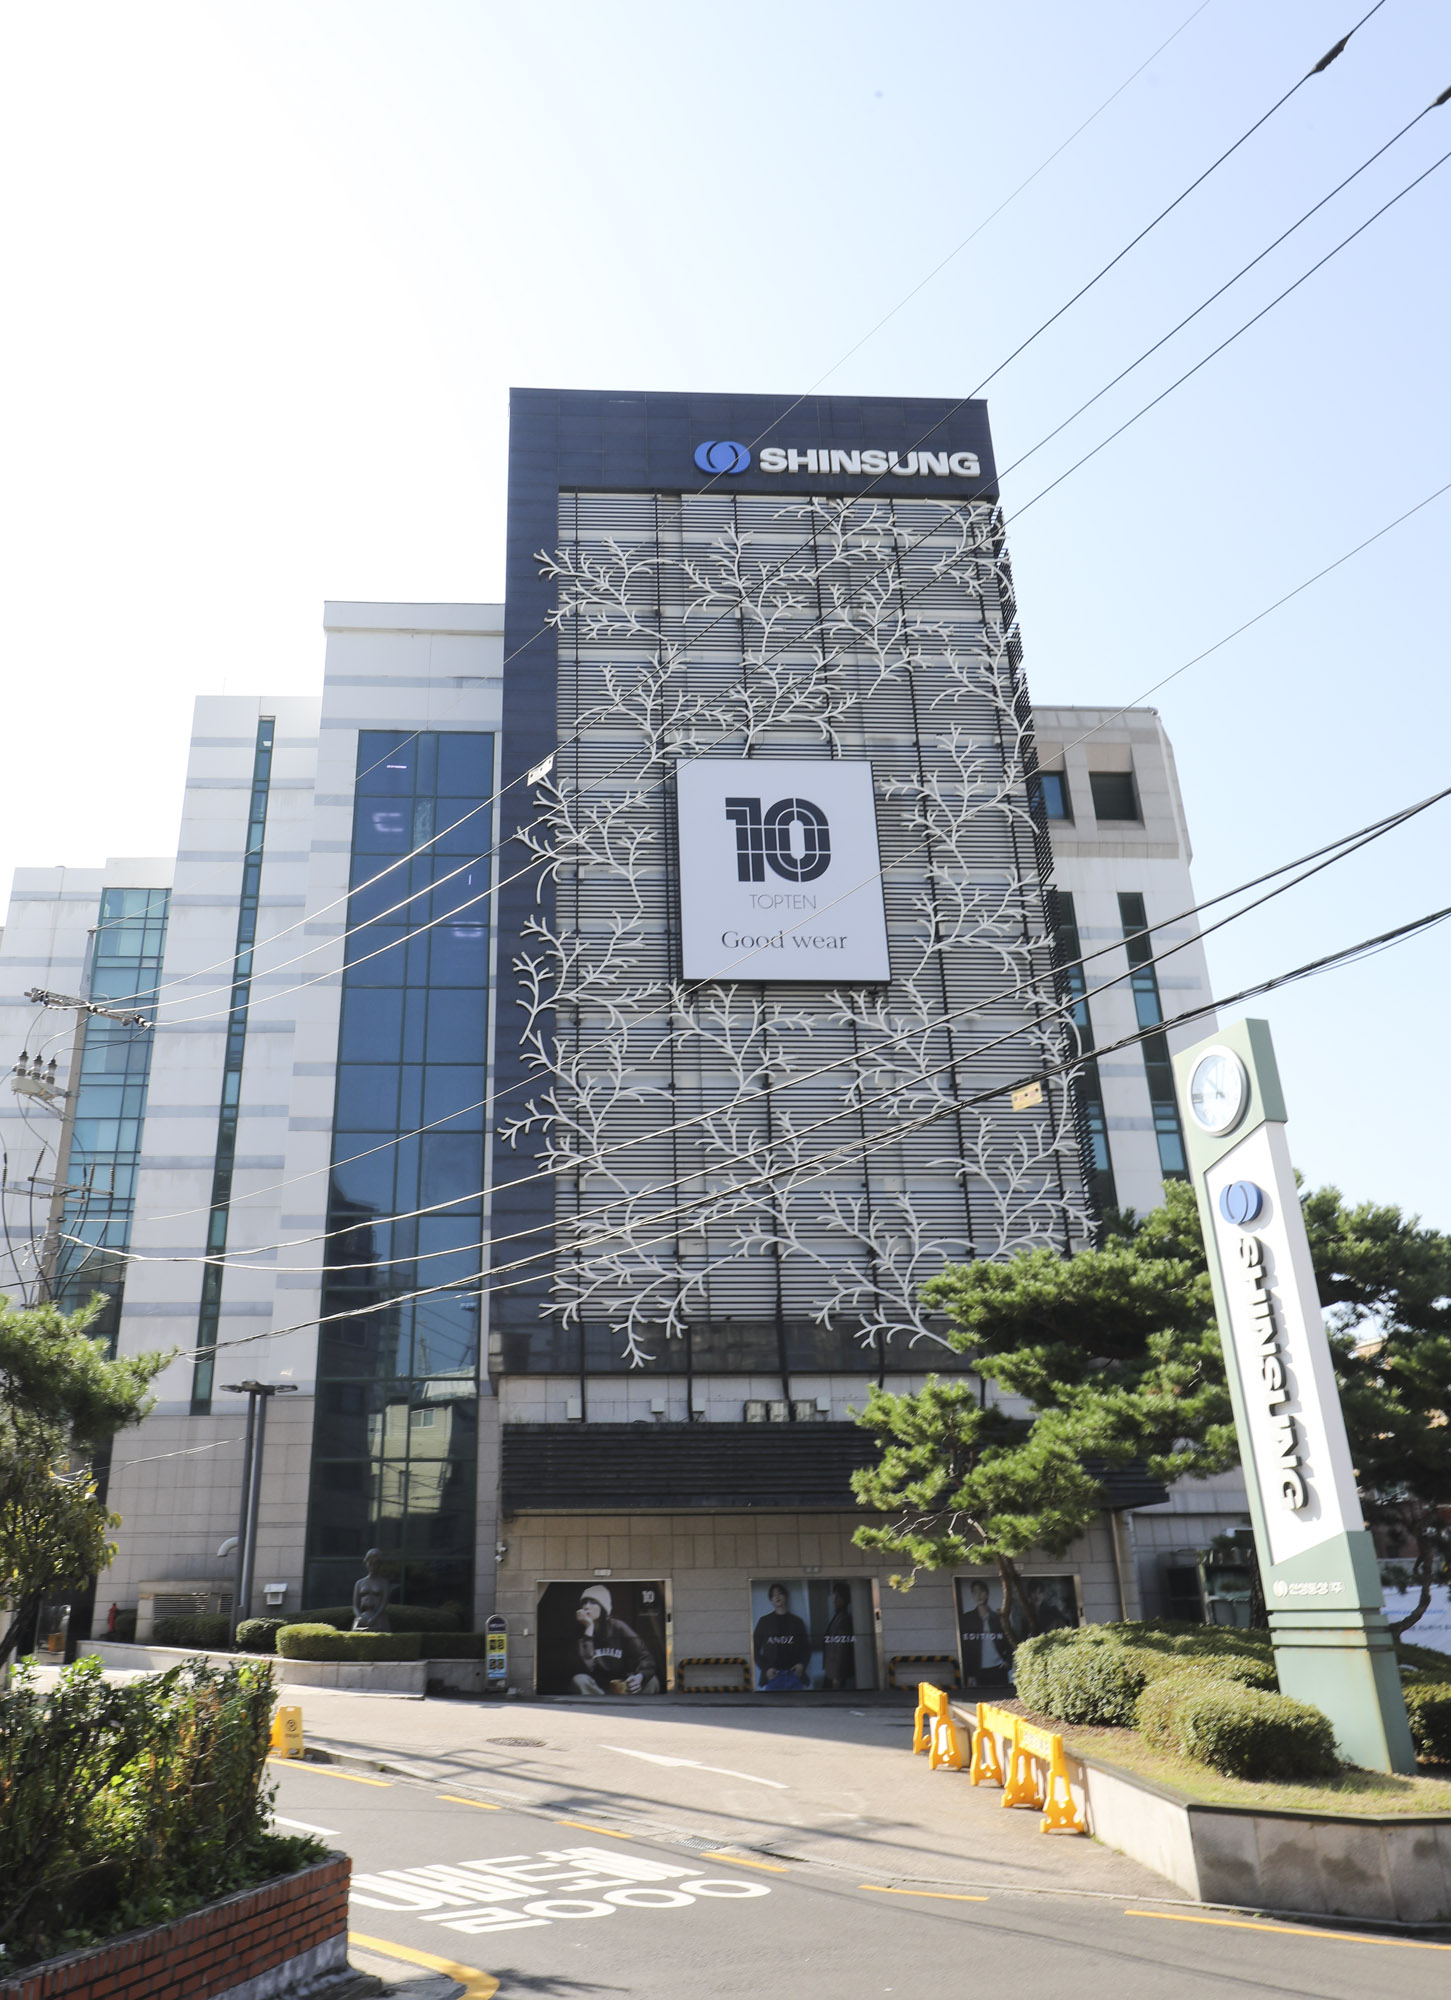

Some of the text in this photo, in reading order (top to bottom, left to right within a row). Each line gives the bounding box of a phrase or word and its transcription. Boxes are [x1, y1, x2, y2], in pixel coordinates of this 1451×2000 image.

[759, 447, 981, 477] SHINSUNG
[725, 797, 832, 883] 10
[749, 894, 818, 910] TOPTEN
[721, 930, 848, 950] Good wear
[1239, 1235, 1309, 1511] SHINSUNG
[641, 1590, 656, 1604] 10
[824, 1634, 857, 1645] ZIOZIA
[962, 1632, 1004, 1641] EDITION
